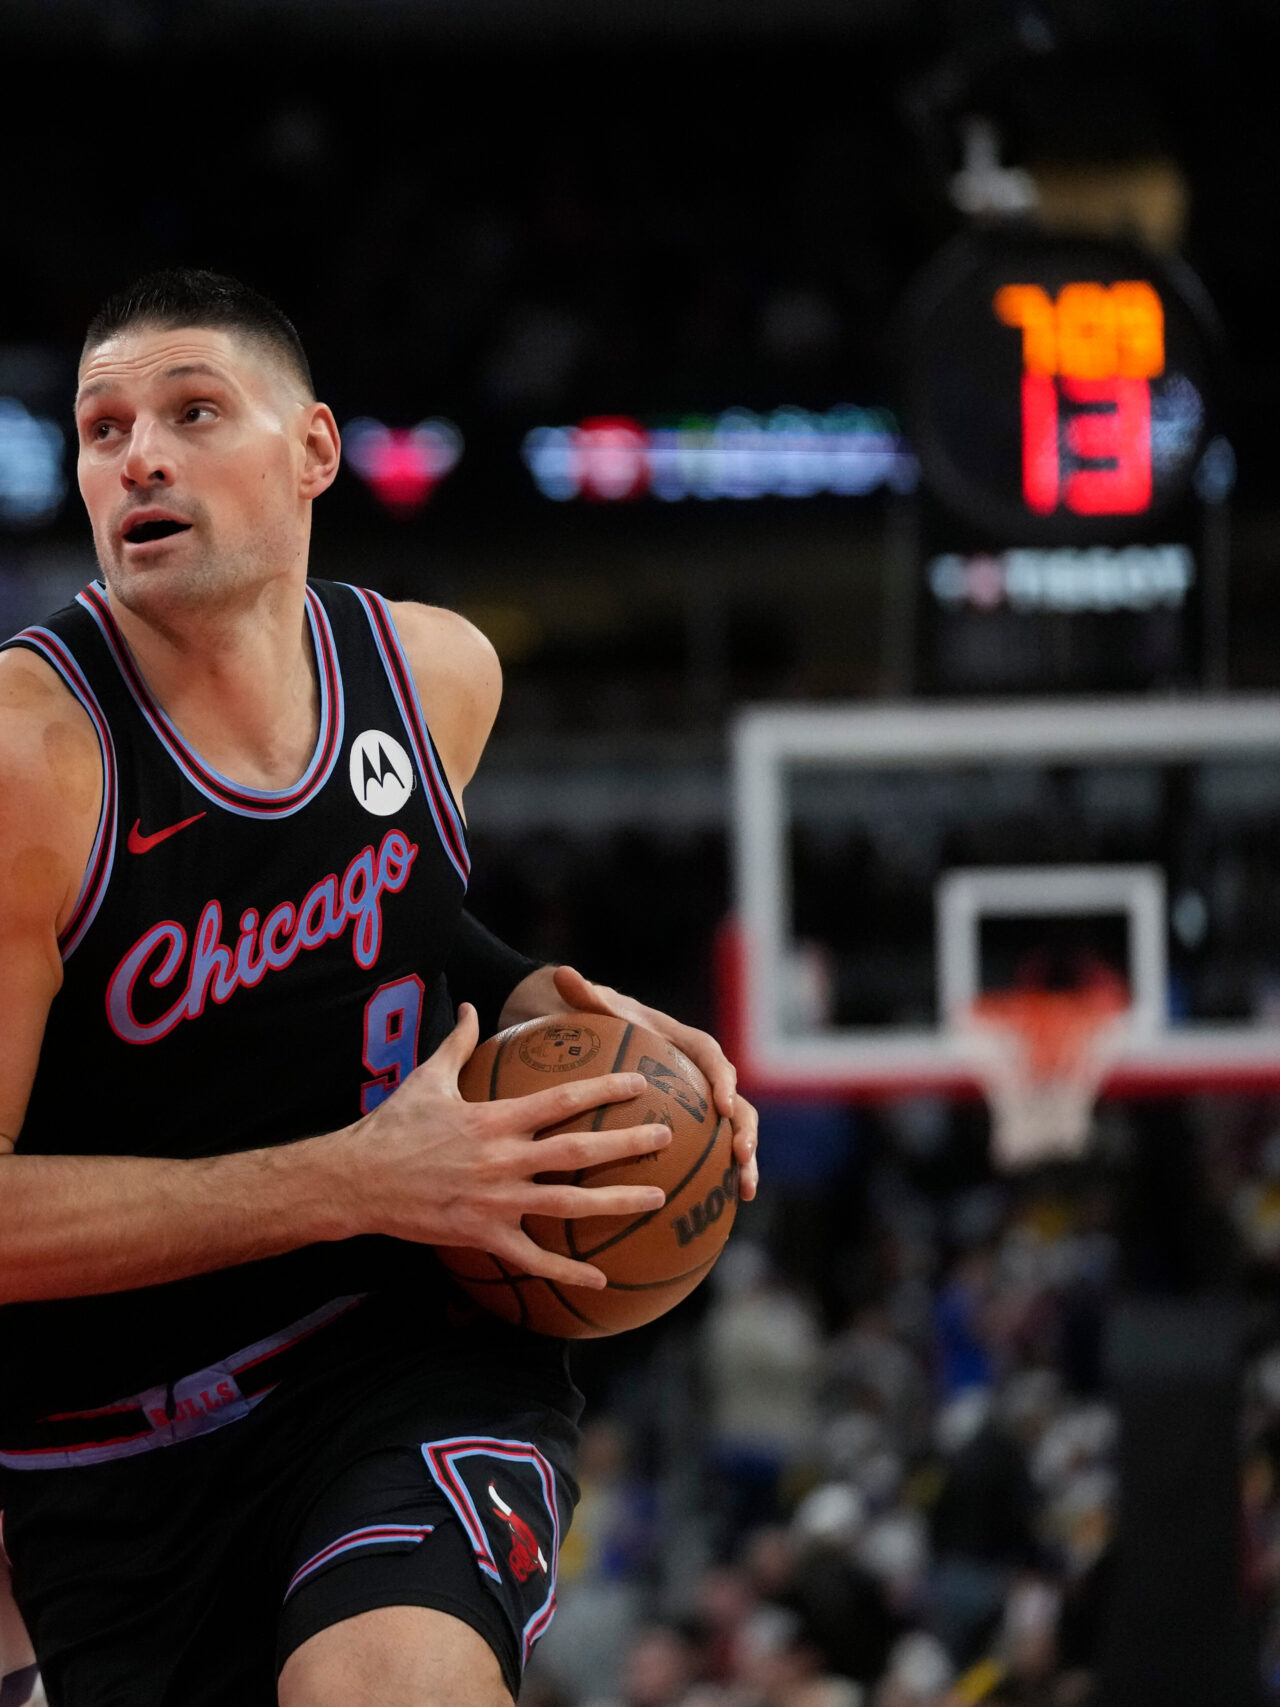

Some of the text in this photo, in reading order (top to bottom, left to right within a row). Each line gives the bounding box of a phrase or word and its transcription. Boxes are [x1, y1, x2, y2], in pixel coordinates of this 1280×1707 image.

[1021, 372, 1153, 516] 13
[106, 829, 418, 1044] Chicago
[361, 973, 426, 1116] 9
